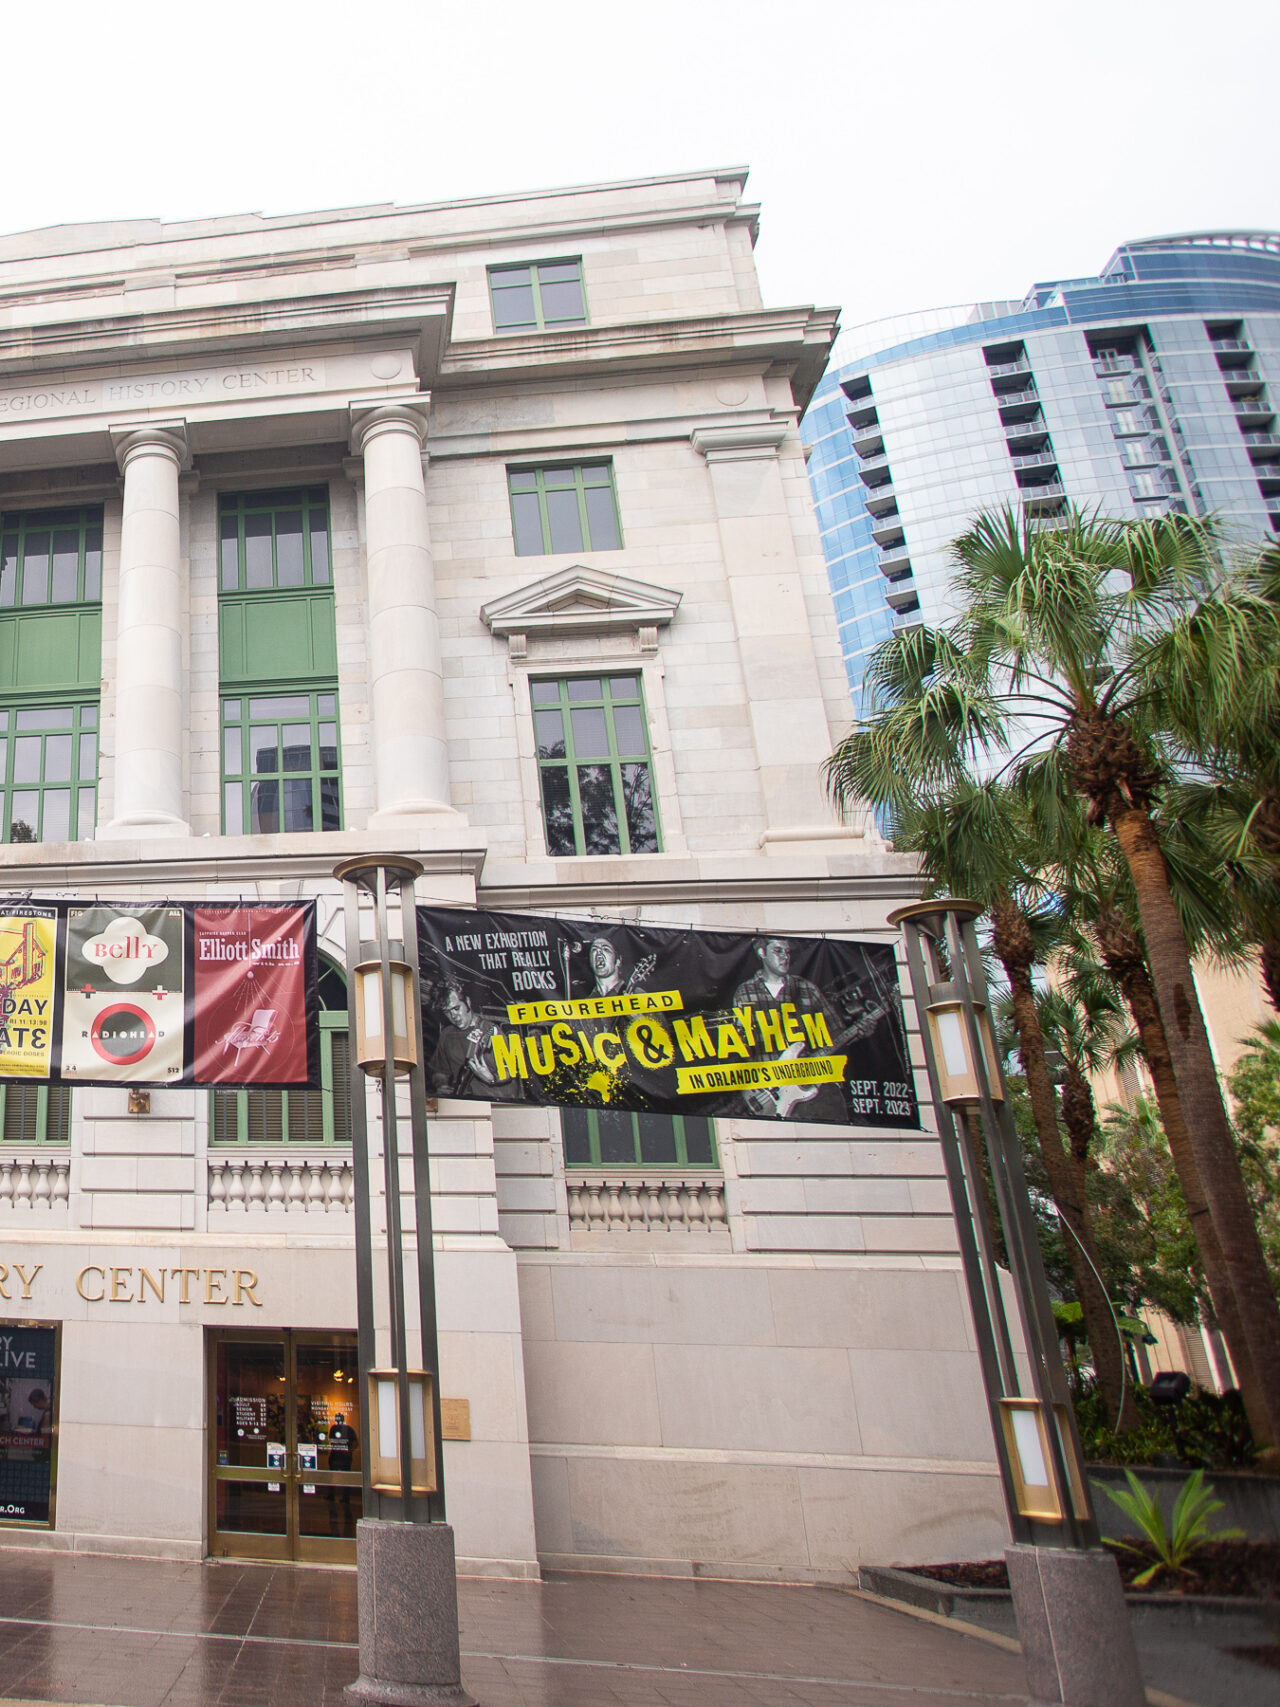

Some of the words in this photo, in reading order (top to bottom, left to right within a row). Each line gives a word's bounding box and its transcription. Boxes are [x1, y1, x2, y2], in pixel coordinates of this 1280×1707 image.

[108, 376, 209, 402] HISTORY
[222, 366, 317, 391] CENTER
[199, 938, 248, 960] Elliott
[251, 937, 300, 960] Smith
[445, 936, 453, 951] A
[456, 934, 482, 950] NEW
[485, 930, 548, 949] EXHIBITION
[478, 953, 509, 970] THAT
[512, 950, 551, 969] REALLY
[512, 970, 557, 991] ROCKS
[2, 999, 48, 1016] DAY
[516, 995, 676, 1020] FIGUREHEAD
[490, 1023, 629, 1081] MUSIC
[637, 1023, 666, 1064] &
[672, 1003, 834, 1062] MAYHEM
[690, 1074, 704, 1089] IN
[706, 1066, 771, 1088] ORLANDO'S
[773, 1060, 834, 1080] UNDERGROUND
[849, 1079, 880, 1096] SEPT.
[883, 1081, 913, 1098] 2022-
[852, 1097, 884, 1114] SEPT.
[885, 1099, 912, 1116] 2023
[76, 1264, 263, 1307] CENTER
[12, 1436, 45, 1447] CENTER
